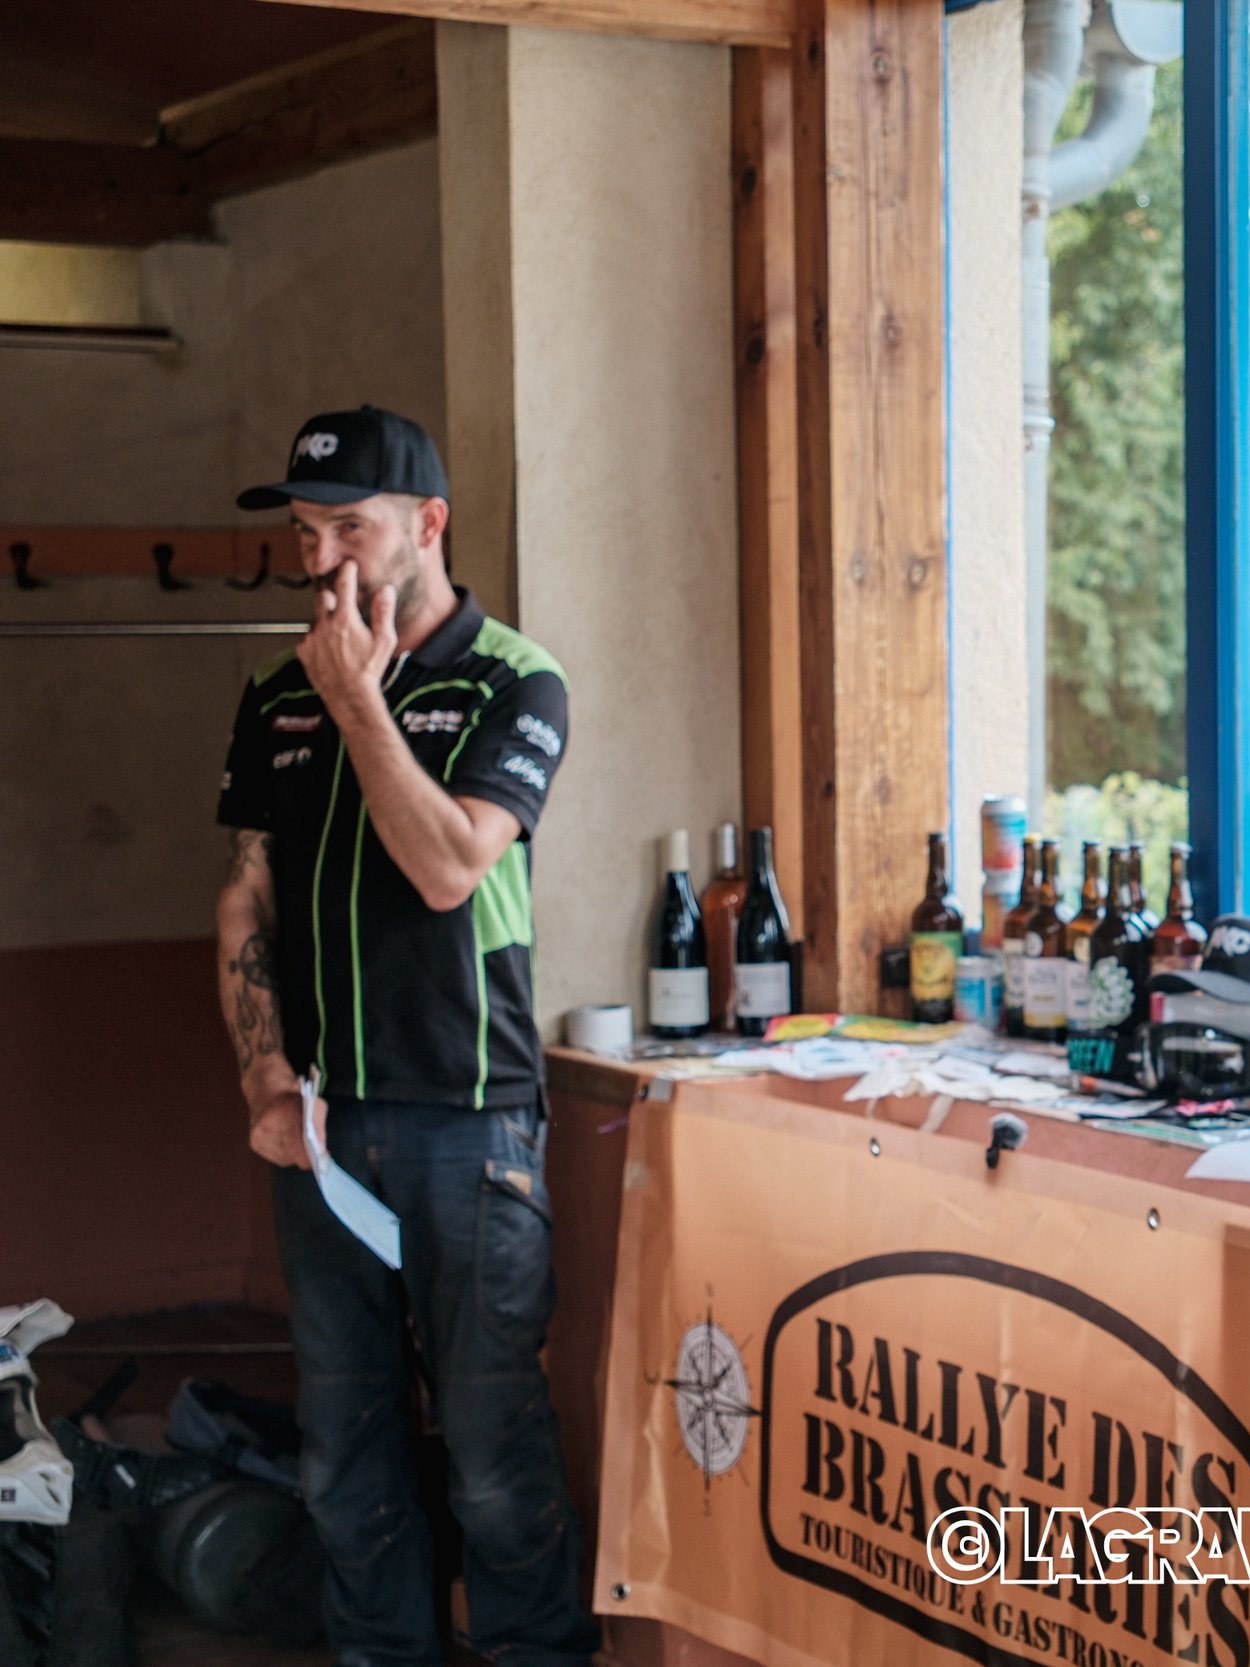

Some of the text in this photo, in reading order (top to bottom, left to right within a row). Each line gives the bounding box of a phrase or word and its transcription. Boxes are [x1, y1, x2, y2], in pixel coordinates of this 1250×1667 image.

[814, 1317, 1237, 1556] RALLYE DES
[800, 1512, 966, 1617] TOURISTIQUE
[971, 1590, 988, 1629] &
